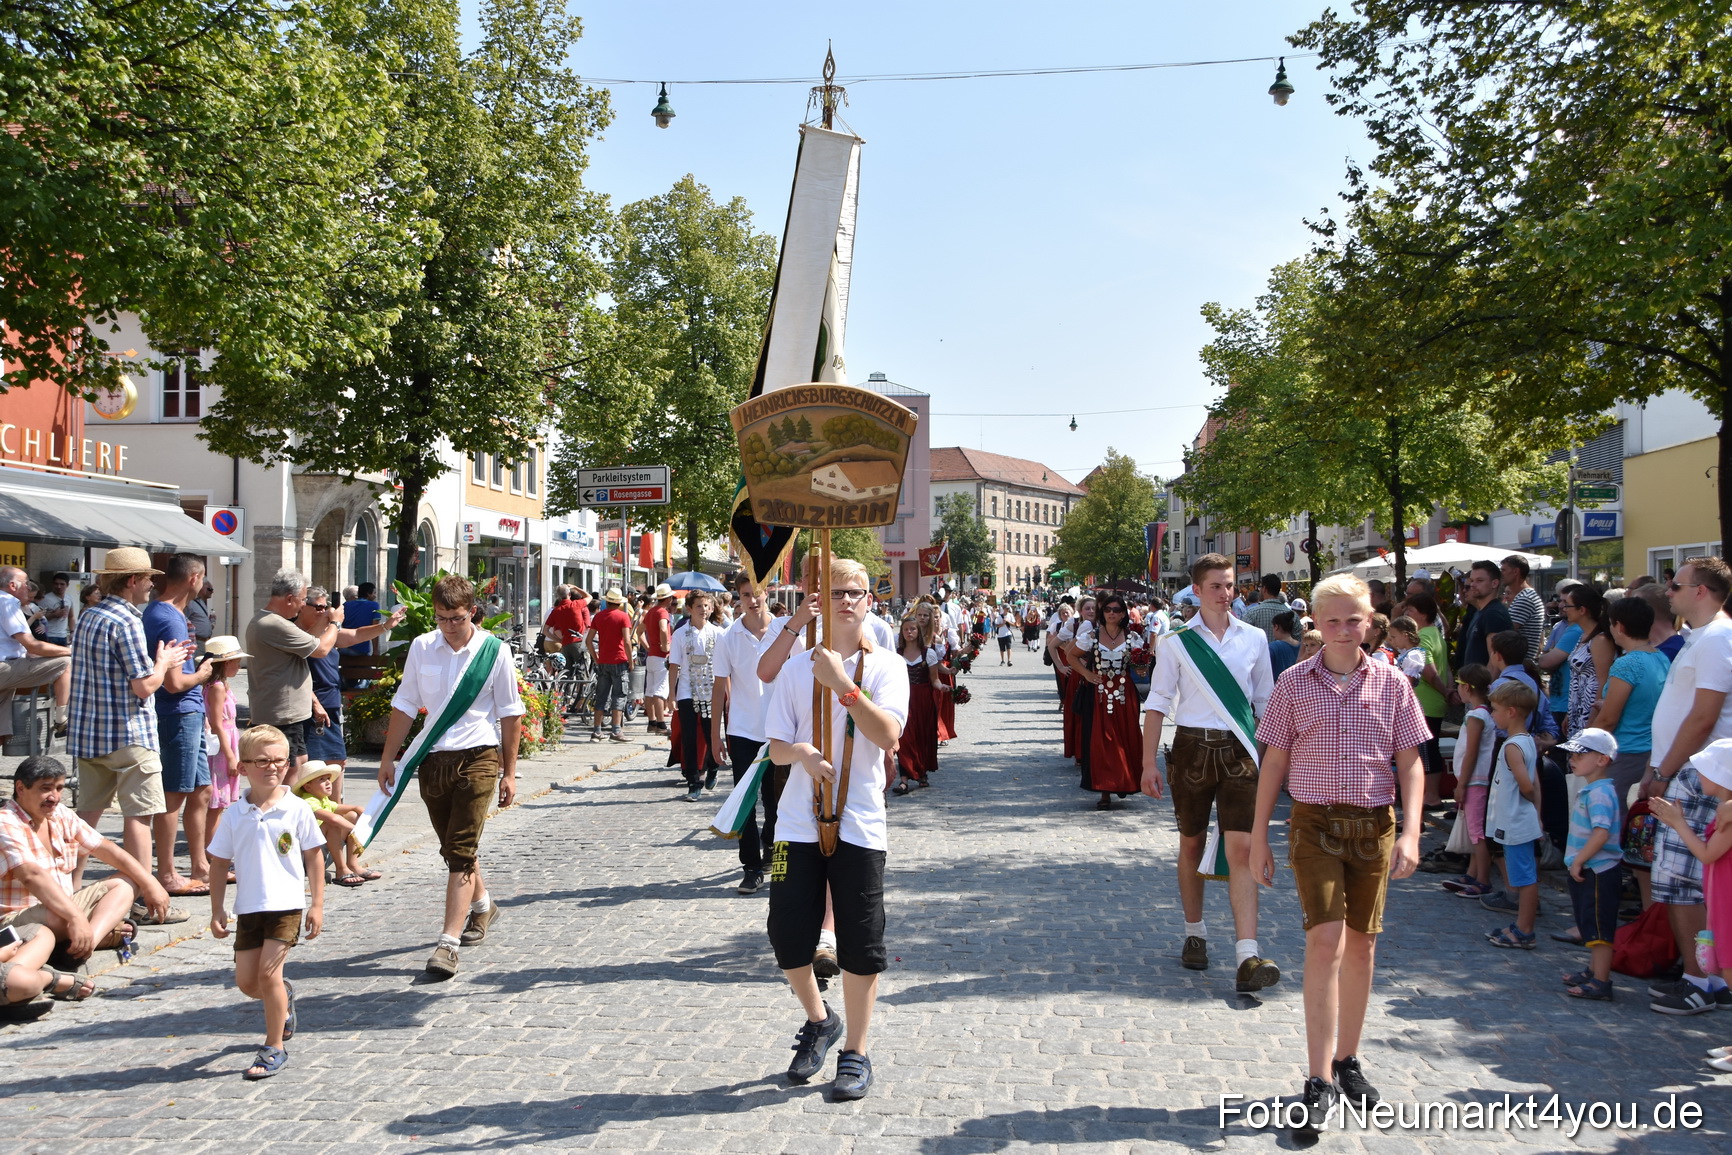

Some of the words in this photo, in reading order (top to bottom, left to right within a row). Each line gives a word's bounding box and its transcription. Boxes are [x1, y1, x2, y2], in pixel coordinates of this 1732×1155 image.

[1, 424, 128, 471] CHLIERF
[592, 472, 651, 483] Parkleitsystem
[1577, 471, 1610, 479] Viehmarkt
[613, 490, 652, 499] Rosengasse
